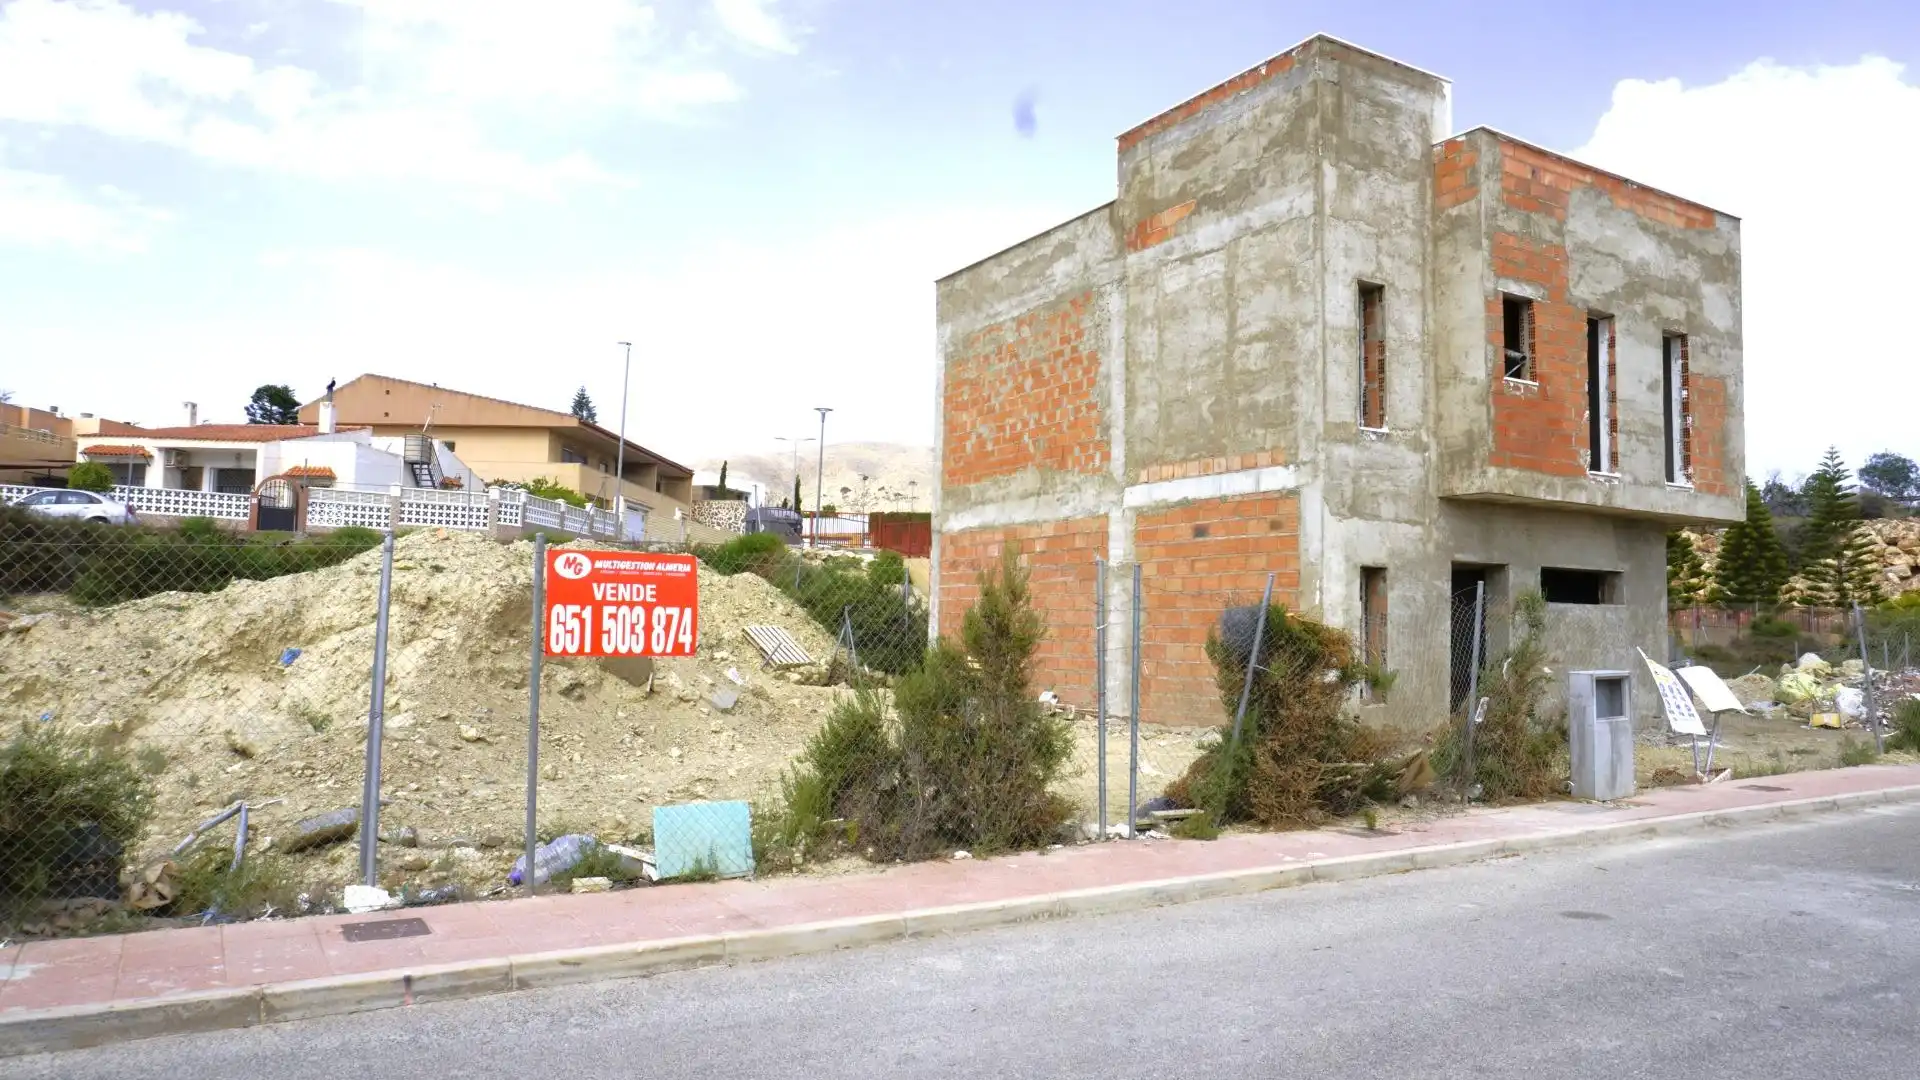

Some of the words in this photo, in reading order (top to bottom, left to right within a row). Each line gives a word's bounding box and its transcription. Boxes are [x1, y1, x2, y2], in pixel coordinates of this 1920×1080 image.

[563, 556, 584, 575] MG
[592, 583, 656, 602] VENDE
[550, 604, 592, 653] 651
[602, 605, 645, 654] 503
[651, 606, 693, 653] 874
